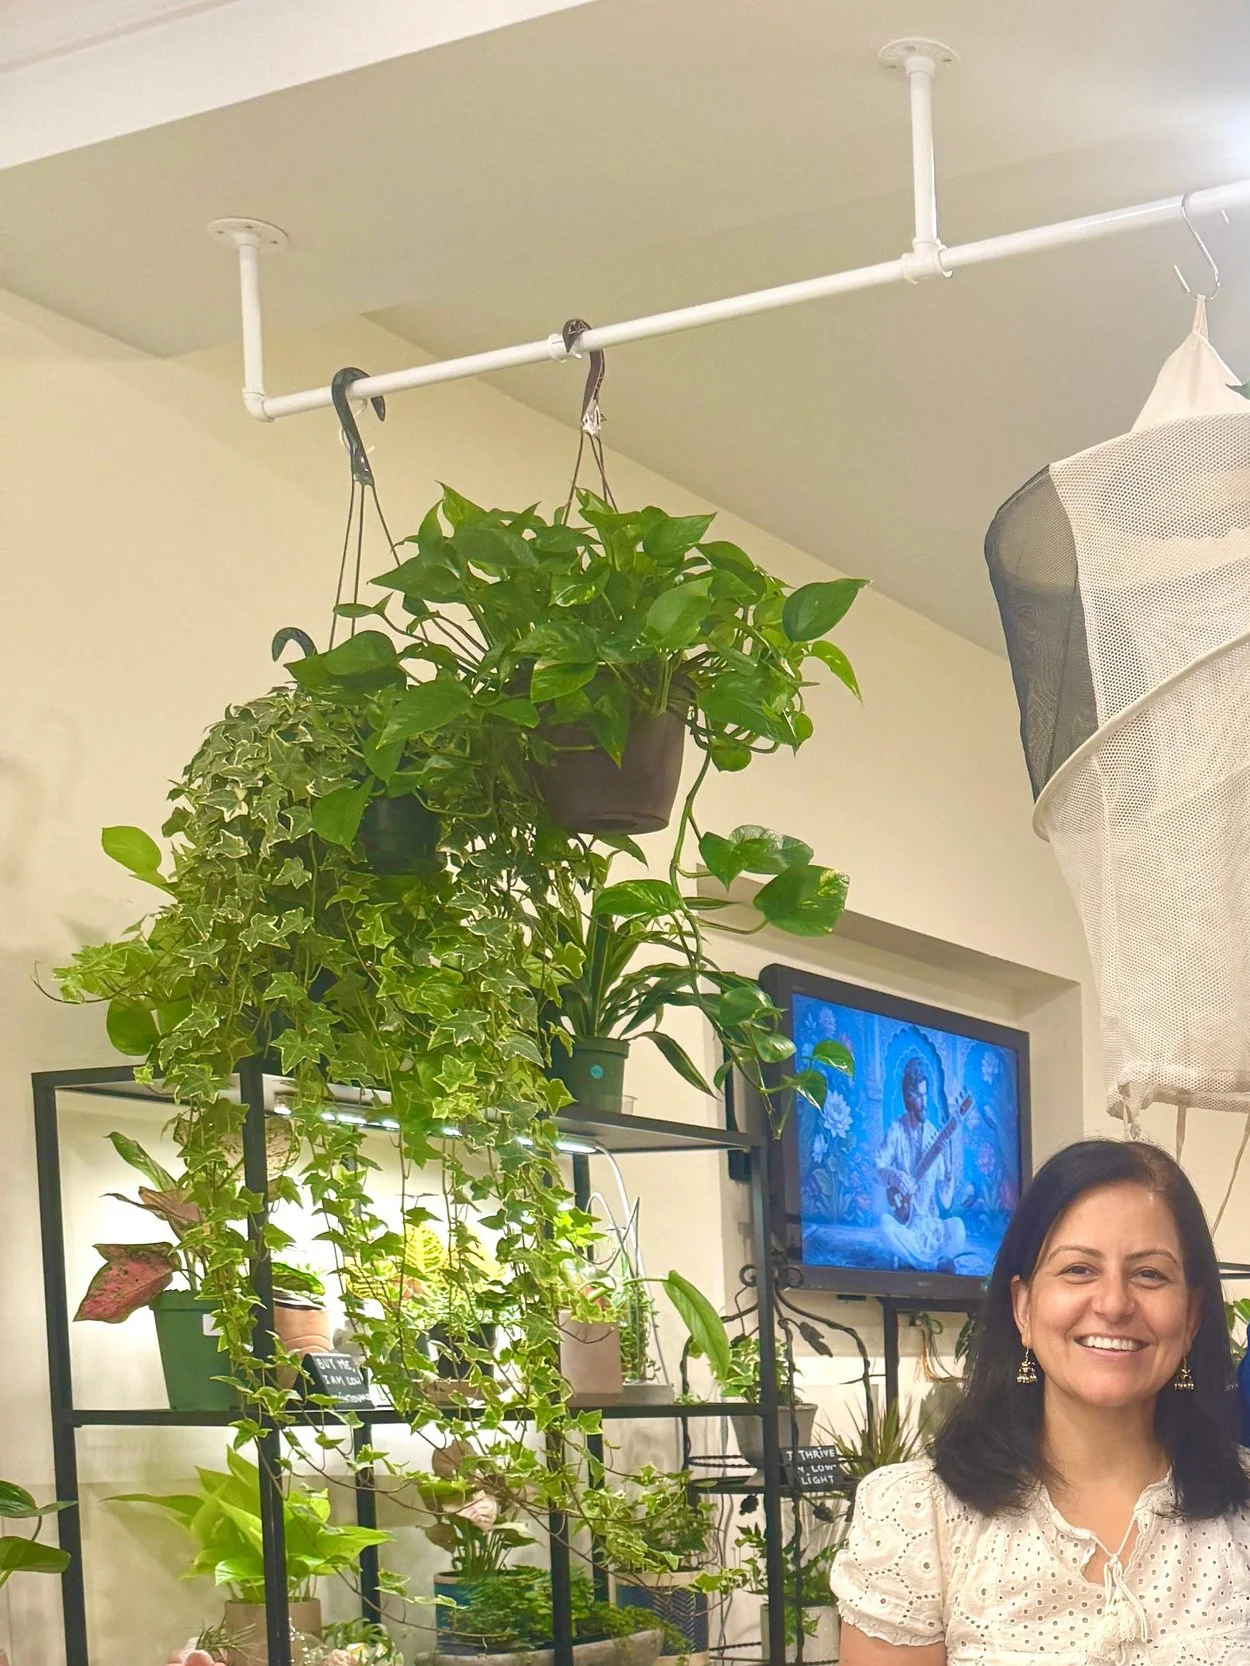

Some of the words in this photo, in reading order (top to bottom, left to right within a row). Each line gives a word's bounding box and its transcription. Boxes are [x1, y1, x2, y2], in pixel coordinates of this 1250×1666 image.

[797, 1447, 836, 1461] THRIVE
[811, 1465, 837, 1473] LOW
[801, 1473, 834, 1485] LIGHT
